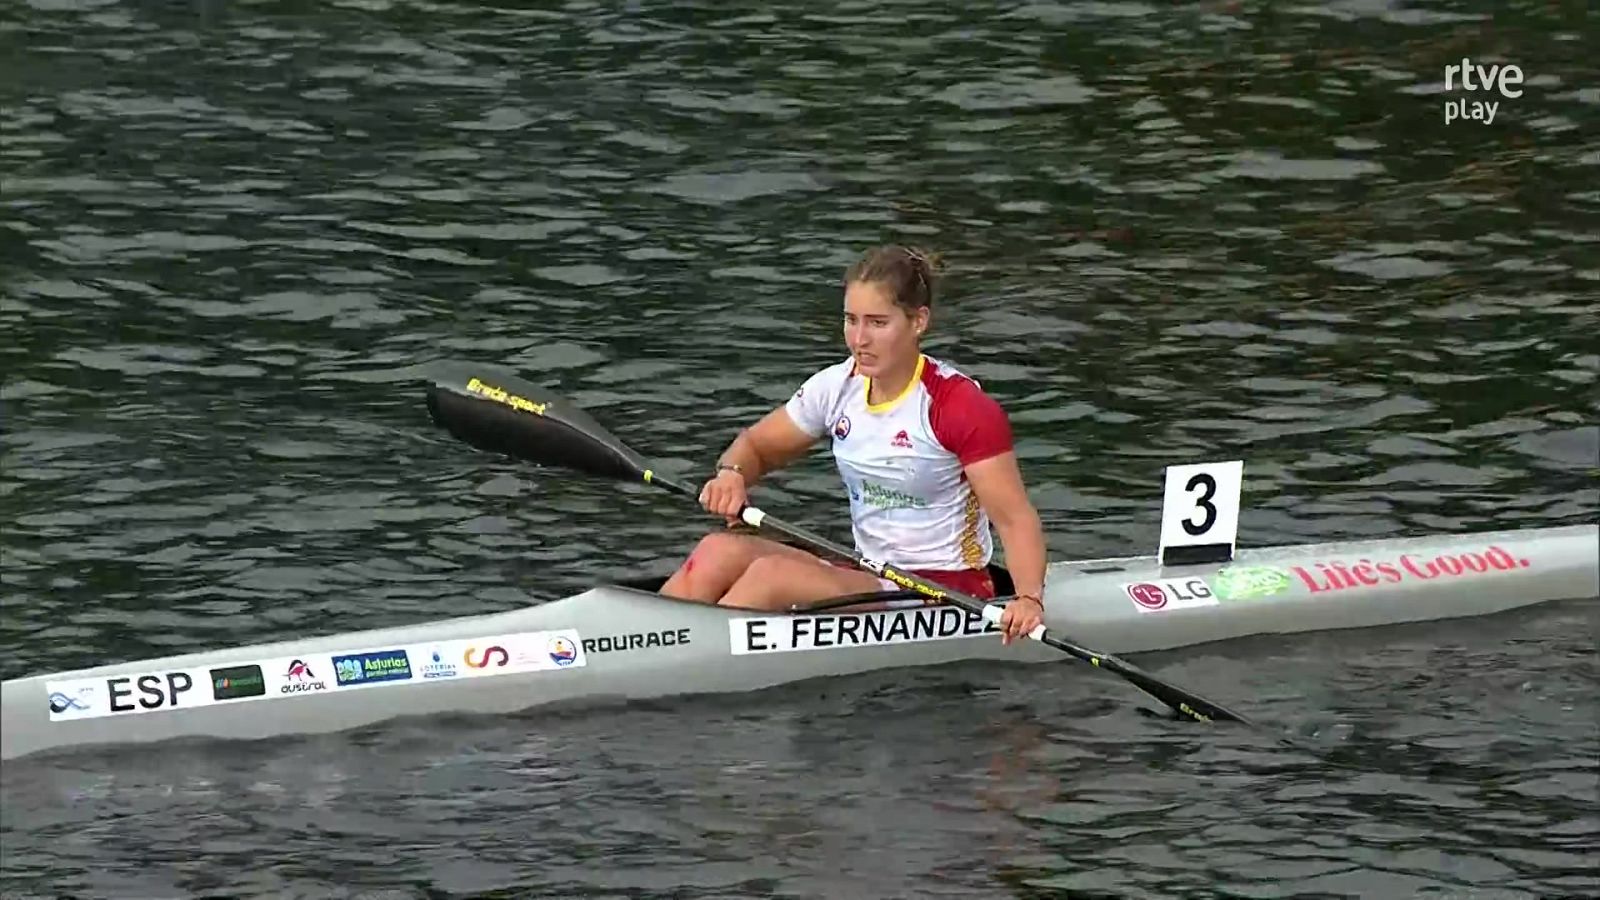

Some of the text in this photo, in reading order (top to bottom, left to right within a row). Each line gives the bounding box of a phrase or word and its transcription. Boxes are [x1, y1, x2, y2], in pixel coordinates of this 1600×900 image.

[1181, 473, 1217, 536] 3
[1290, 559, 1402, 593] Life's
[1400, 546, 1530, 580] Good.
[1168, 580, 1212, 601] LG
[746, 621, 777, 650] E.
[364, 657, 408, 671] Asturias
[107, 672, 193, 711] ESP
[281, 681, 328, 694] austral
